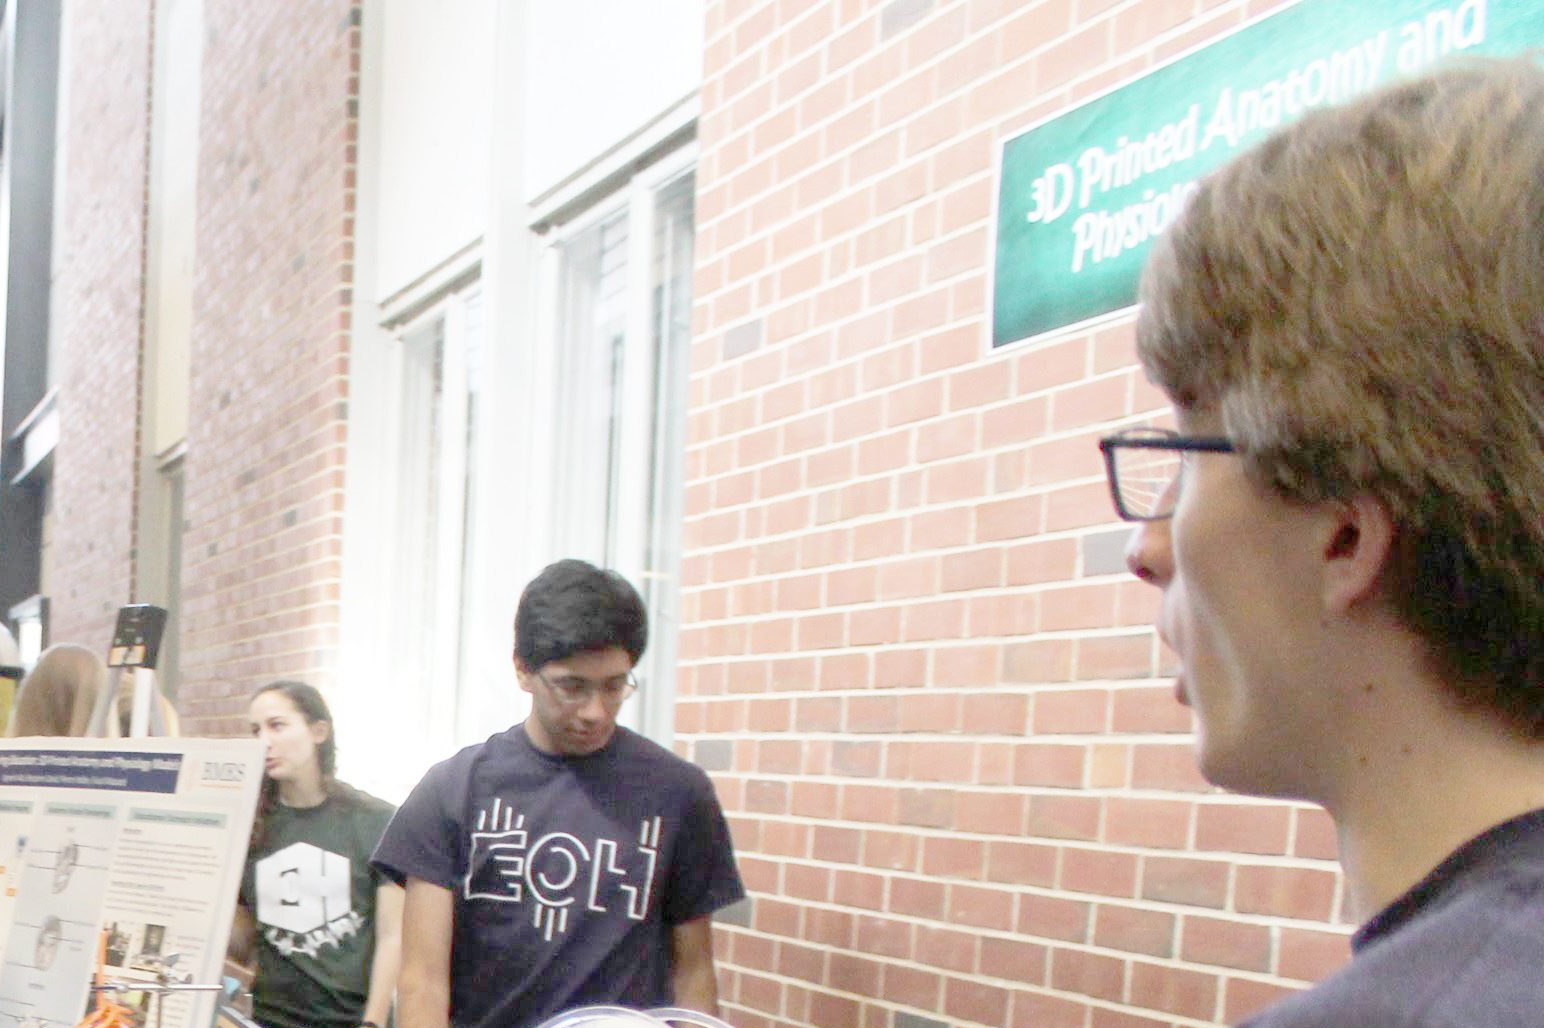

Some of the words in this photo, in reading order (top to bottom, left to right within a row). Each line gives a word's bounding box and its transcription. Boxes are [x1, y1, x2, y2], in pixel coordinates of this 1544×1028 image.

[1027, 164, 1075, 225] 3D
[1077, 104, 1200, 209] Printed
[1200, 29, 1389, 151] Anatomy
[1392, 0, 1487, 74] and
